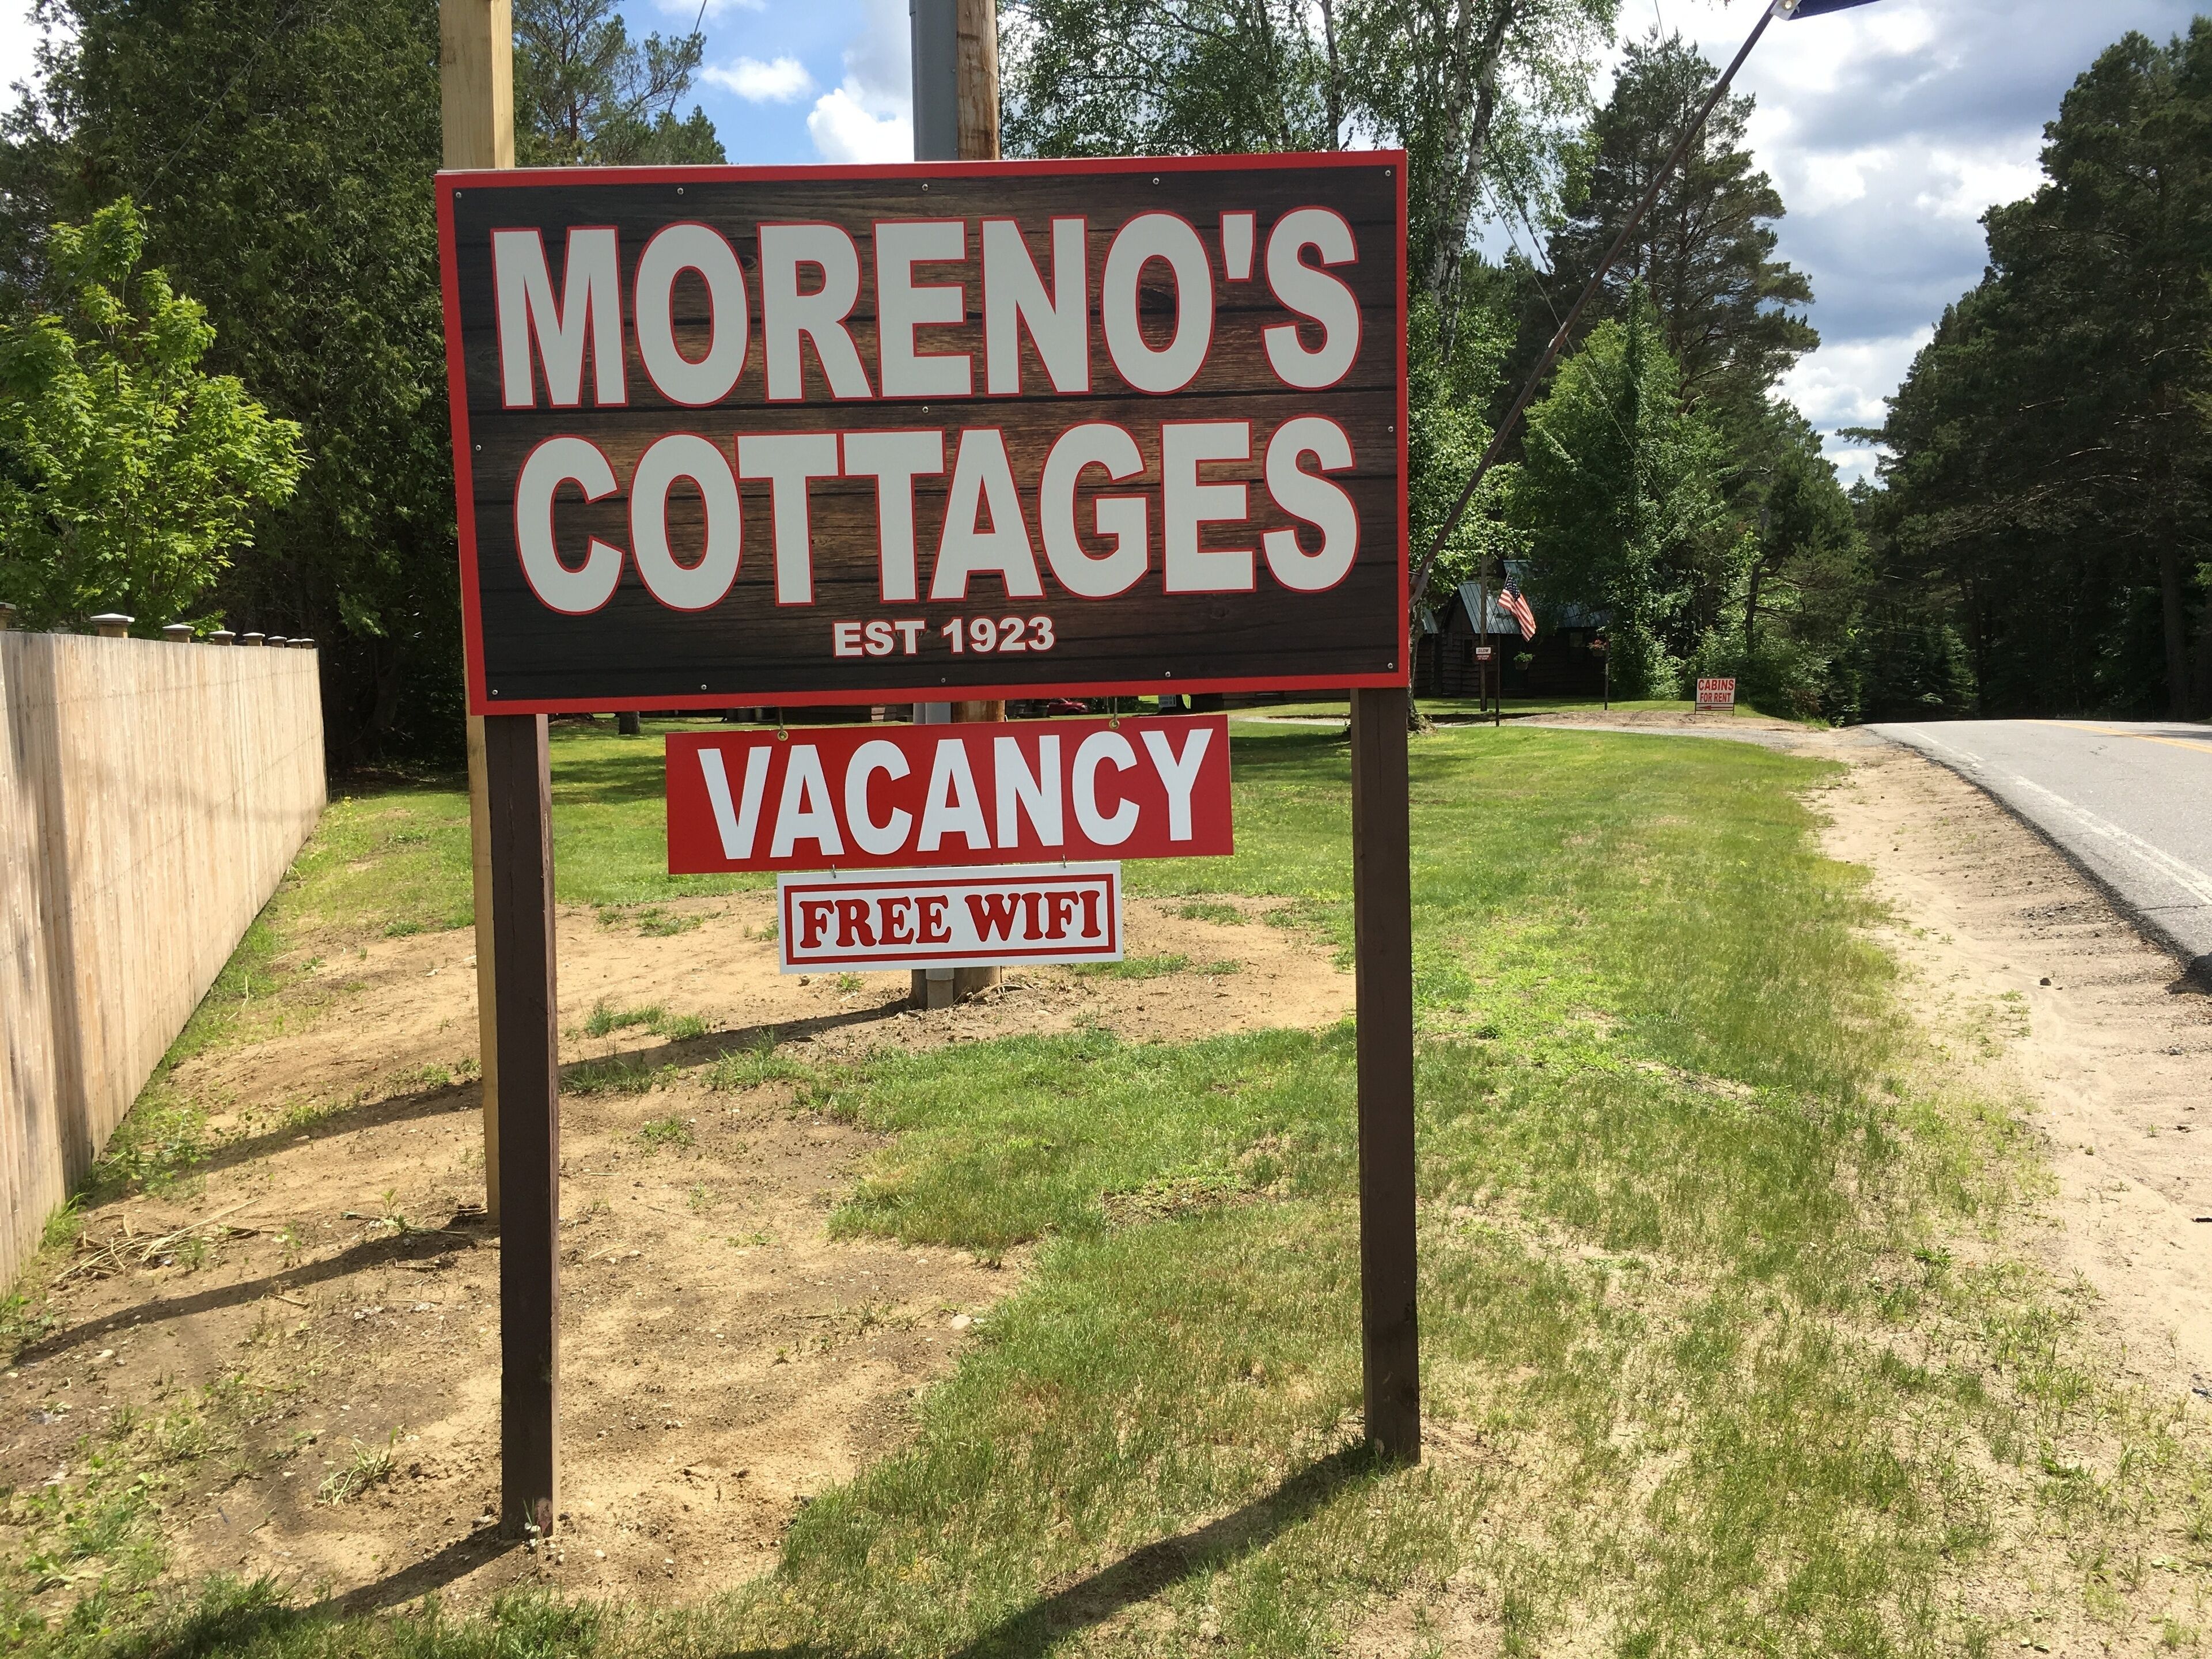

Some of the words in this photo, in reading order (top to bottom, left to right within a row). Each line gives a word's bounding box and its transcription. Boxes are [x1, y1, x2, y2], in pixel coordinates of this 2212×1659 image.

[491, 206, 1363, 408] MORENO'S
[514, 415, 1361, 614] COTTAGES
[833, 619, 926, 657] EST
[941, 615, 1056, 654] 1923
[1698, 679, 1734, 691] CABINS
[1700, 692, 1712, 702] FOR
[1714, 692, 1732, 702] RENT
[697, 728, 1213, 860] VACANCY
[799, 893, 952, 949] FREE
[964, 889, 1101, 943] WIFI
